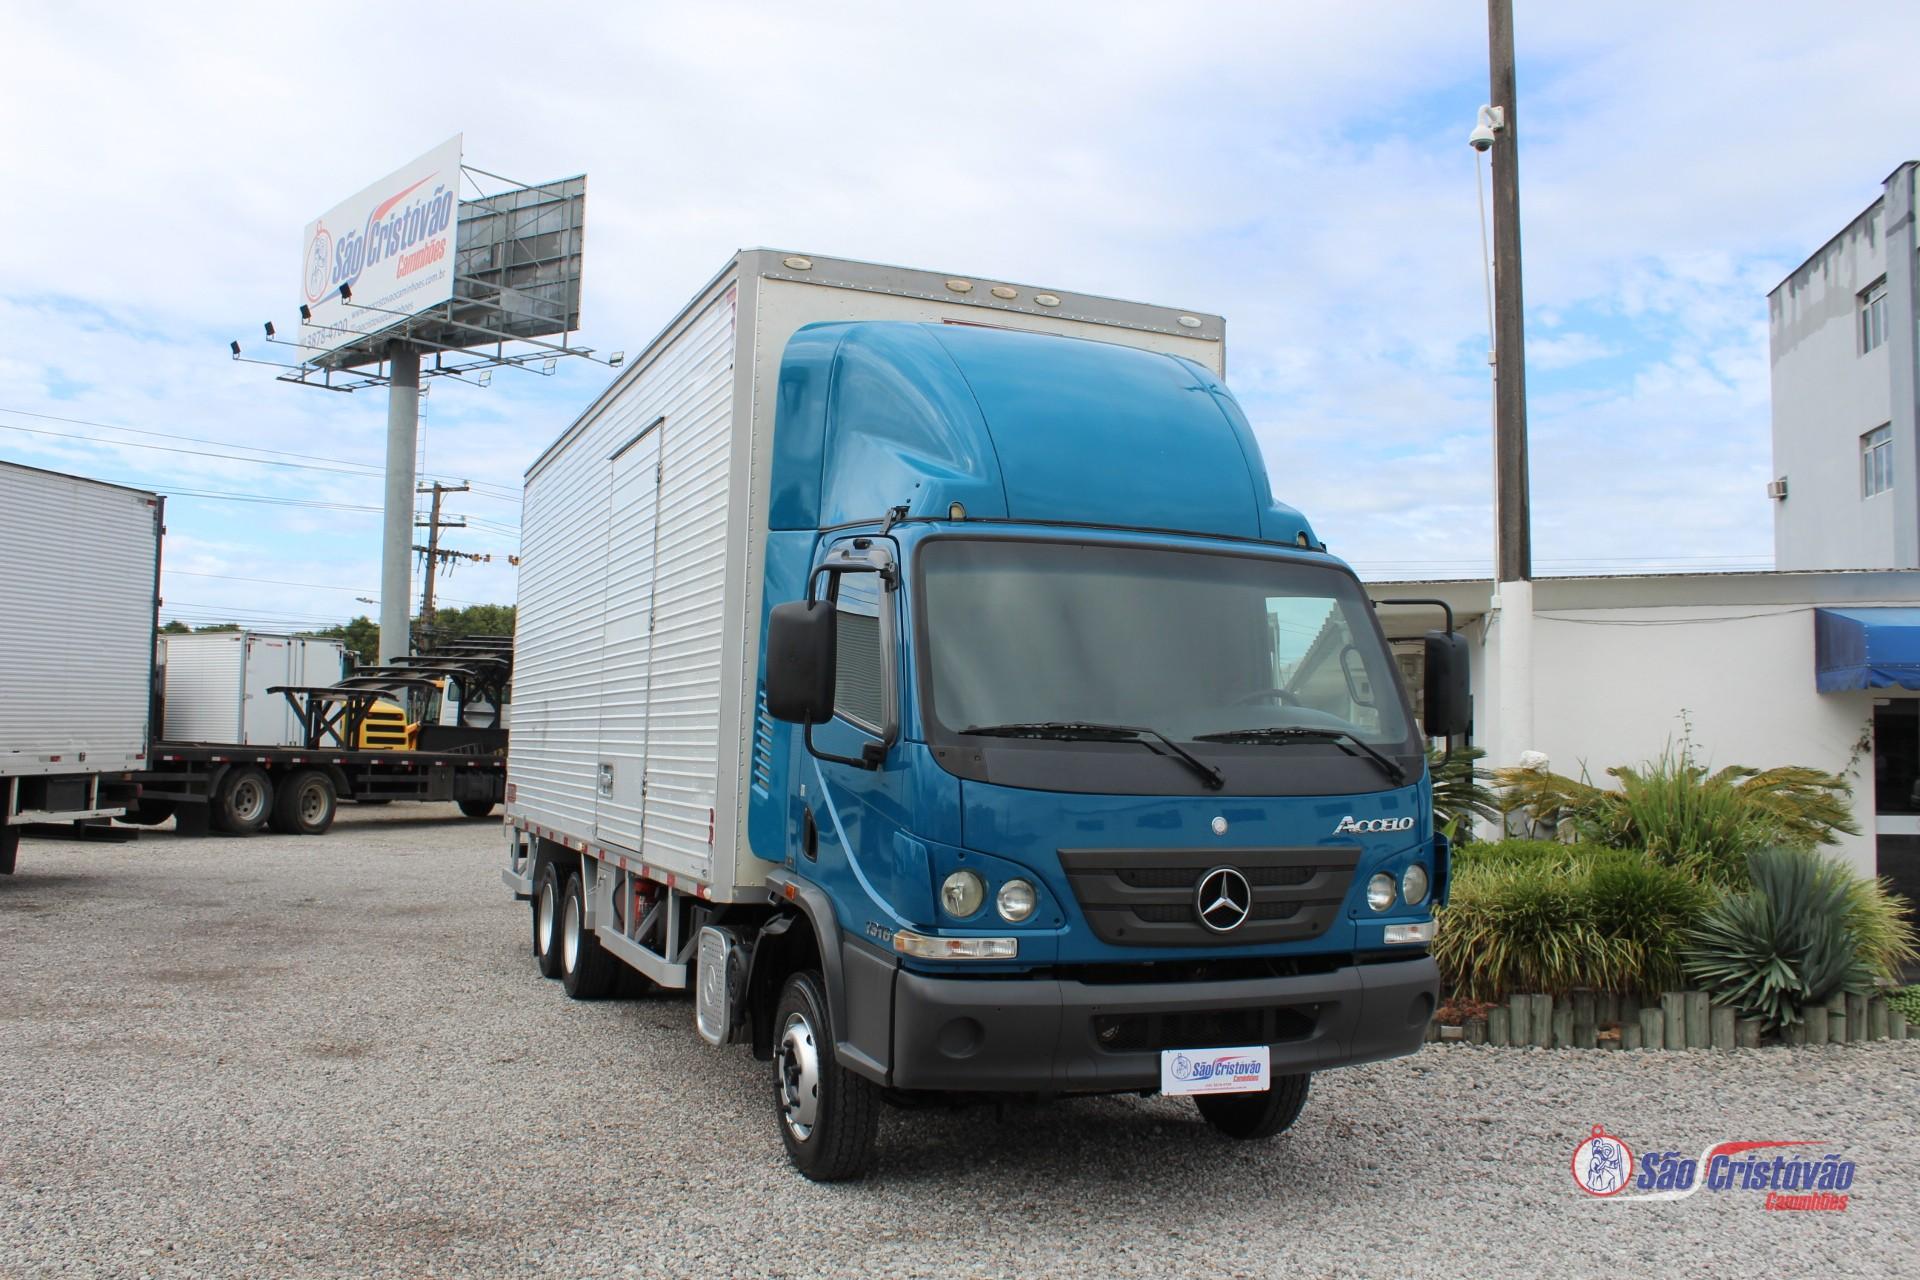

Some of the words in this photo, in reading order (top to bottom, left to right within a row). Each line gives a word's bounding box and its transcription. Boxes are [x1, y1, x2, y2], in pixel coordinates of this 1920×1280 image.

[332, 230, 363, 285] São
[367, 184, 453, 268] Cristóvão
[396, 238, 446, 279] Caminhões
[1332, 815, 1415, 835] ACCELO
[1192, 1061, 1212, 1077] São
[1215, 1060, 1261, 1076] Cristóvão
